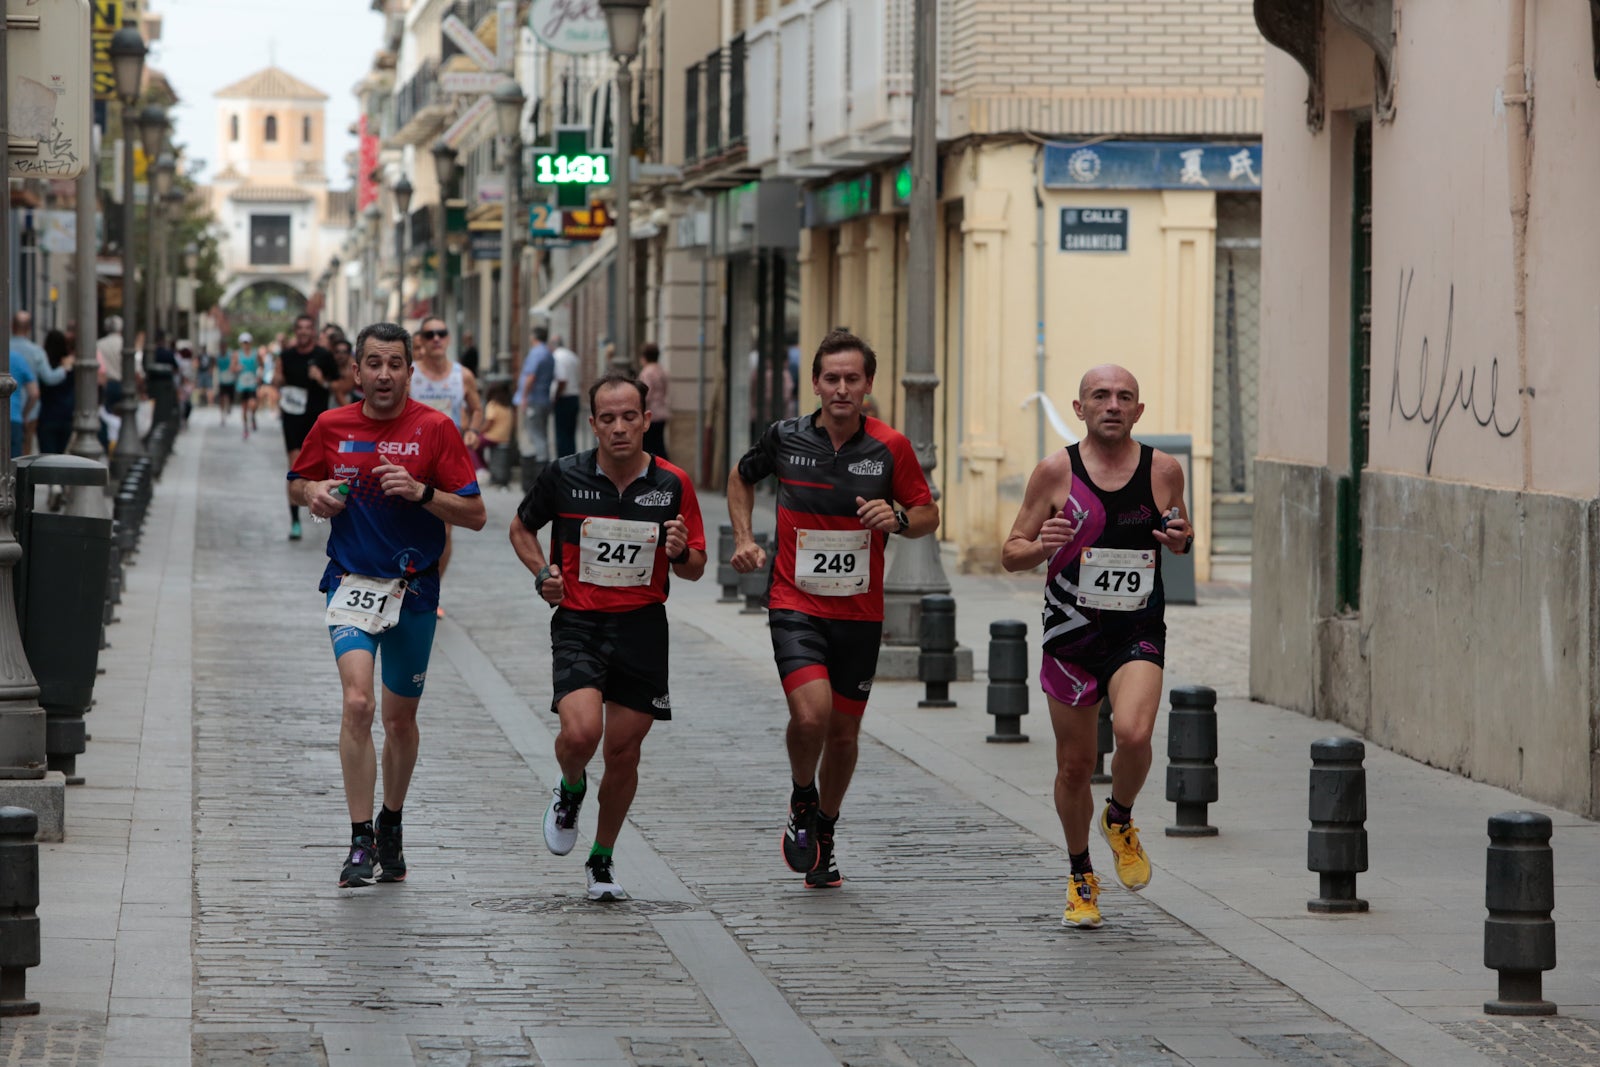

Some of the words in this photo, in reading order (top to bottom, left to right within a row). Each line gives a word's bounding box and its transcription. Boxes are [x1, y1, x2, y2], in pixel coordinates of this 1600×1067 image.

[1081, 210, 1124, 223] CALLE
[377, 441, 420, 456] SEUR
[848, 459, 885, 475] ATARFE
[571, 489, 601, 500] GOBIK
[636, 490, 673, 506] ATARFE
[596, 541, 642, 564] 247
[813, 553, 856, 573] 249
[1094, 570, 1141, 593] 479
[346, 590, 389, 614] 351
